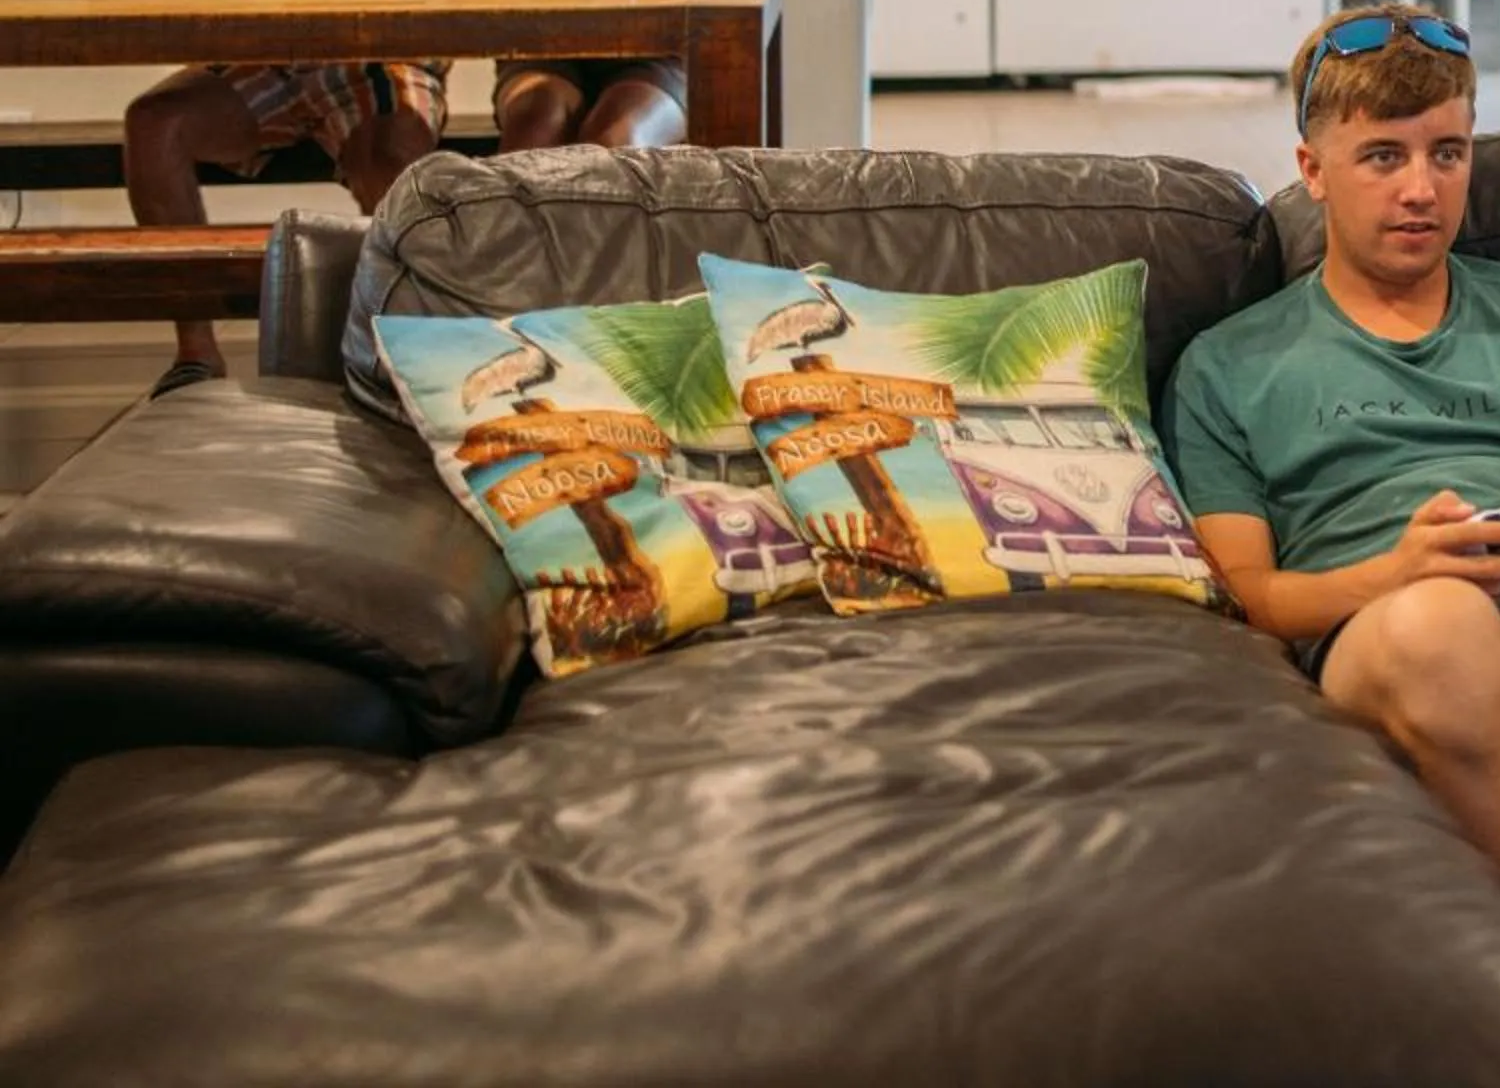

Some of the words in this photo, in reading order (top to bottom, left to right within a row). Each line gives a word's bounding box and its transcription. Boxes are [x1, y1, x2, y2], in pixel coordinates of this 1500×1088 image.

[756, 383, 848, 409] Fraser
[860, 384, 945, 414] Island
[1314, 400, 1409, 428] JACK
[775, 420, 887, 476] Noosa
[499, 462, 618, 517] Noosa
